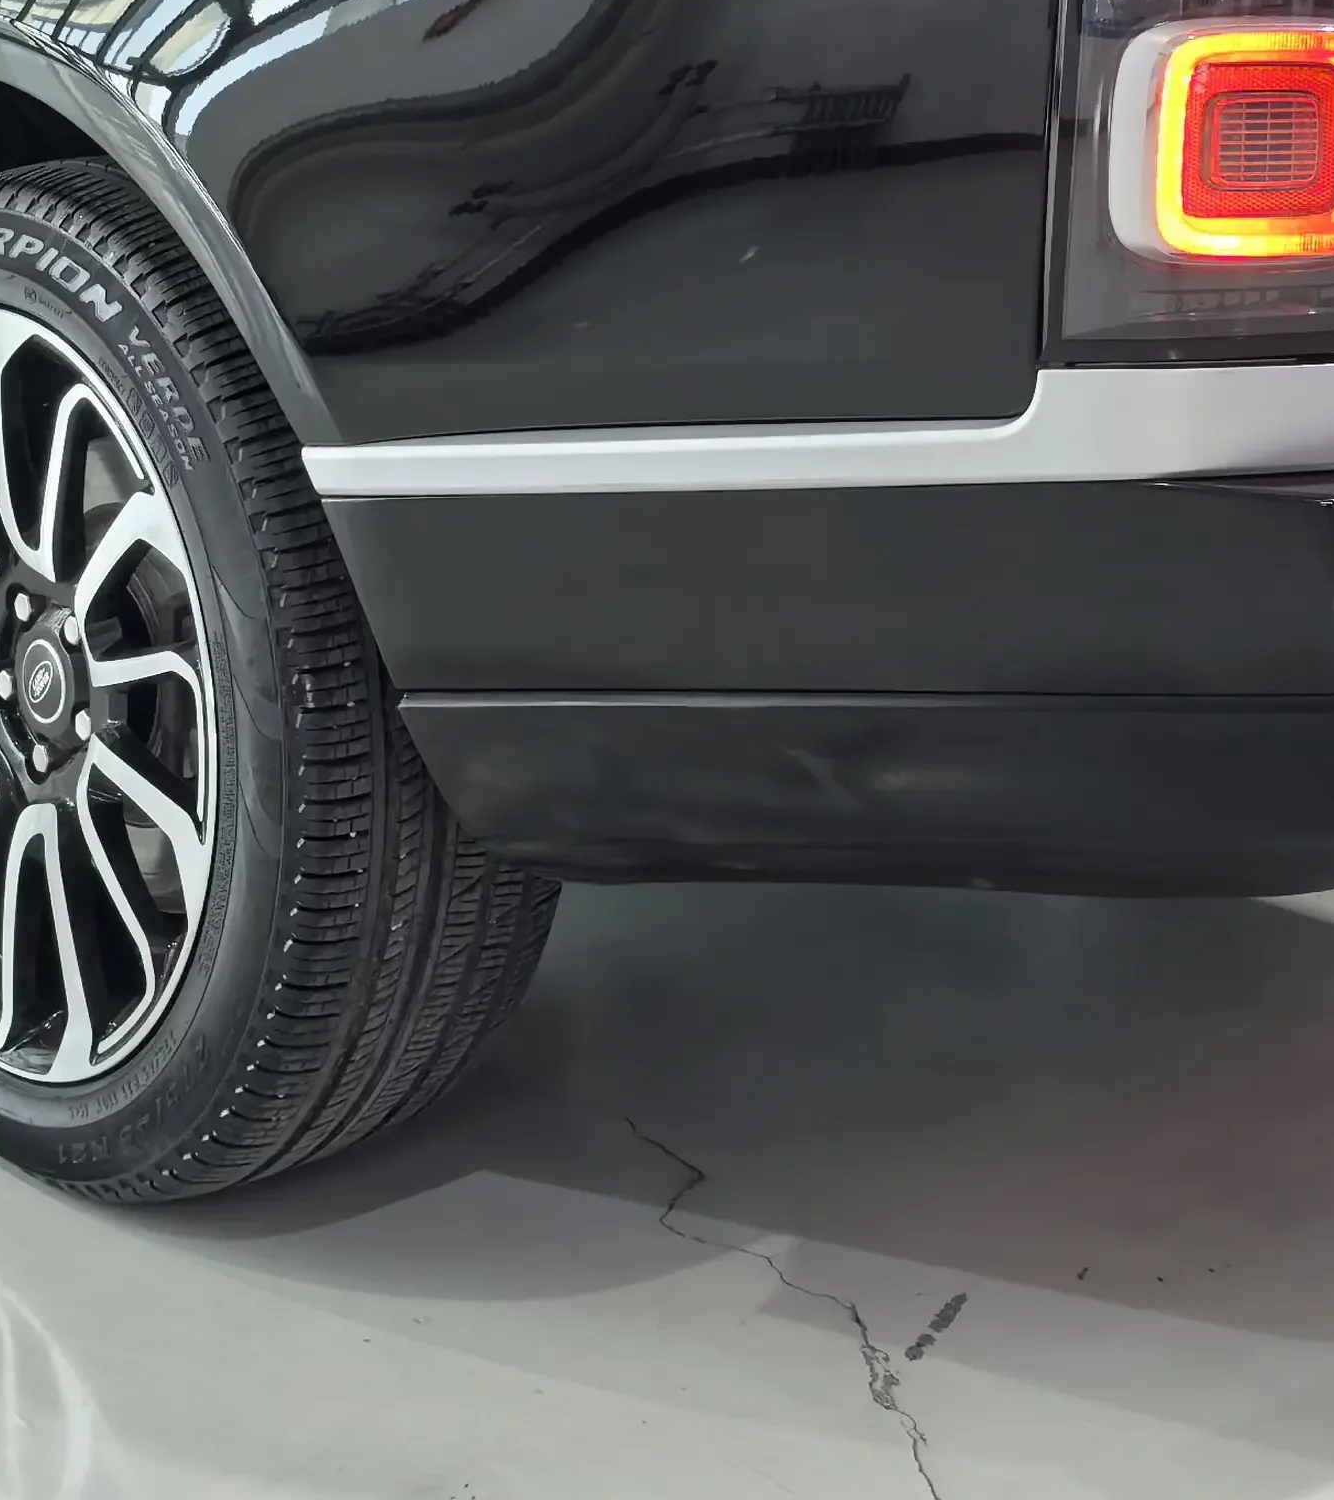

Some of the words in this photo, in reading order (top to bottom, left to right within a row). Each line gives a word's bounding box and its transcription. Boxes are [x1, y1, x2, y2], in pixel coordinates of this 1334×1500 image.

[118, 344, 142, 378] ALL
[144, 380, 194, 470] SEASON
[128, 325, 210, 463] VERDE
